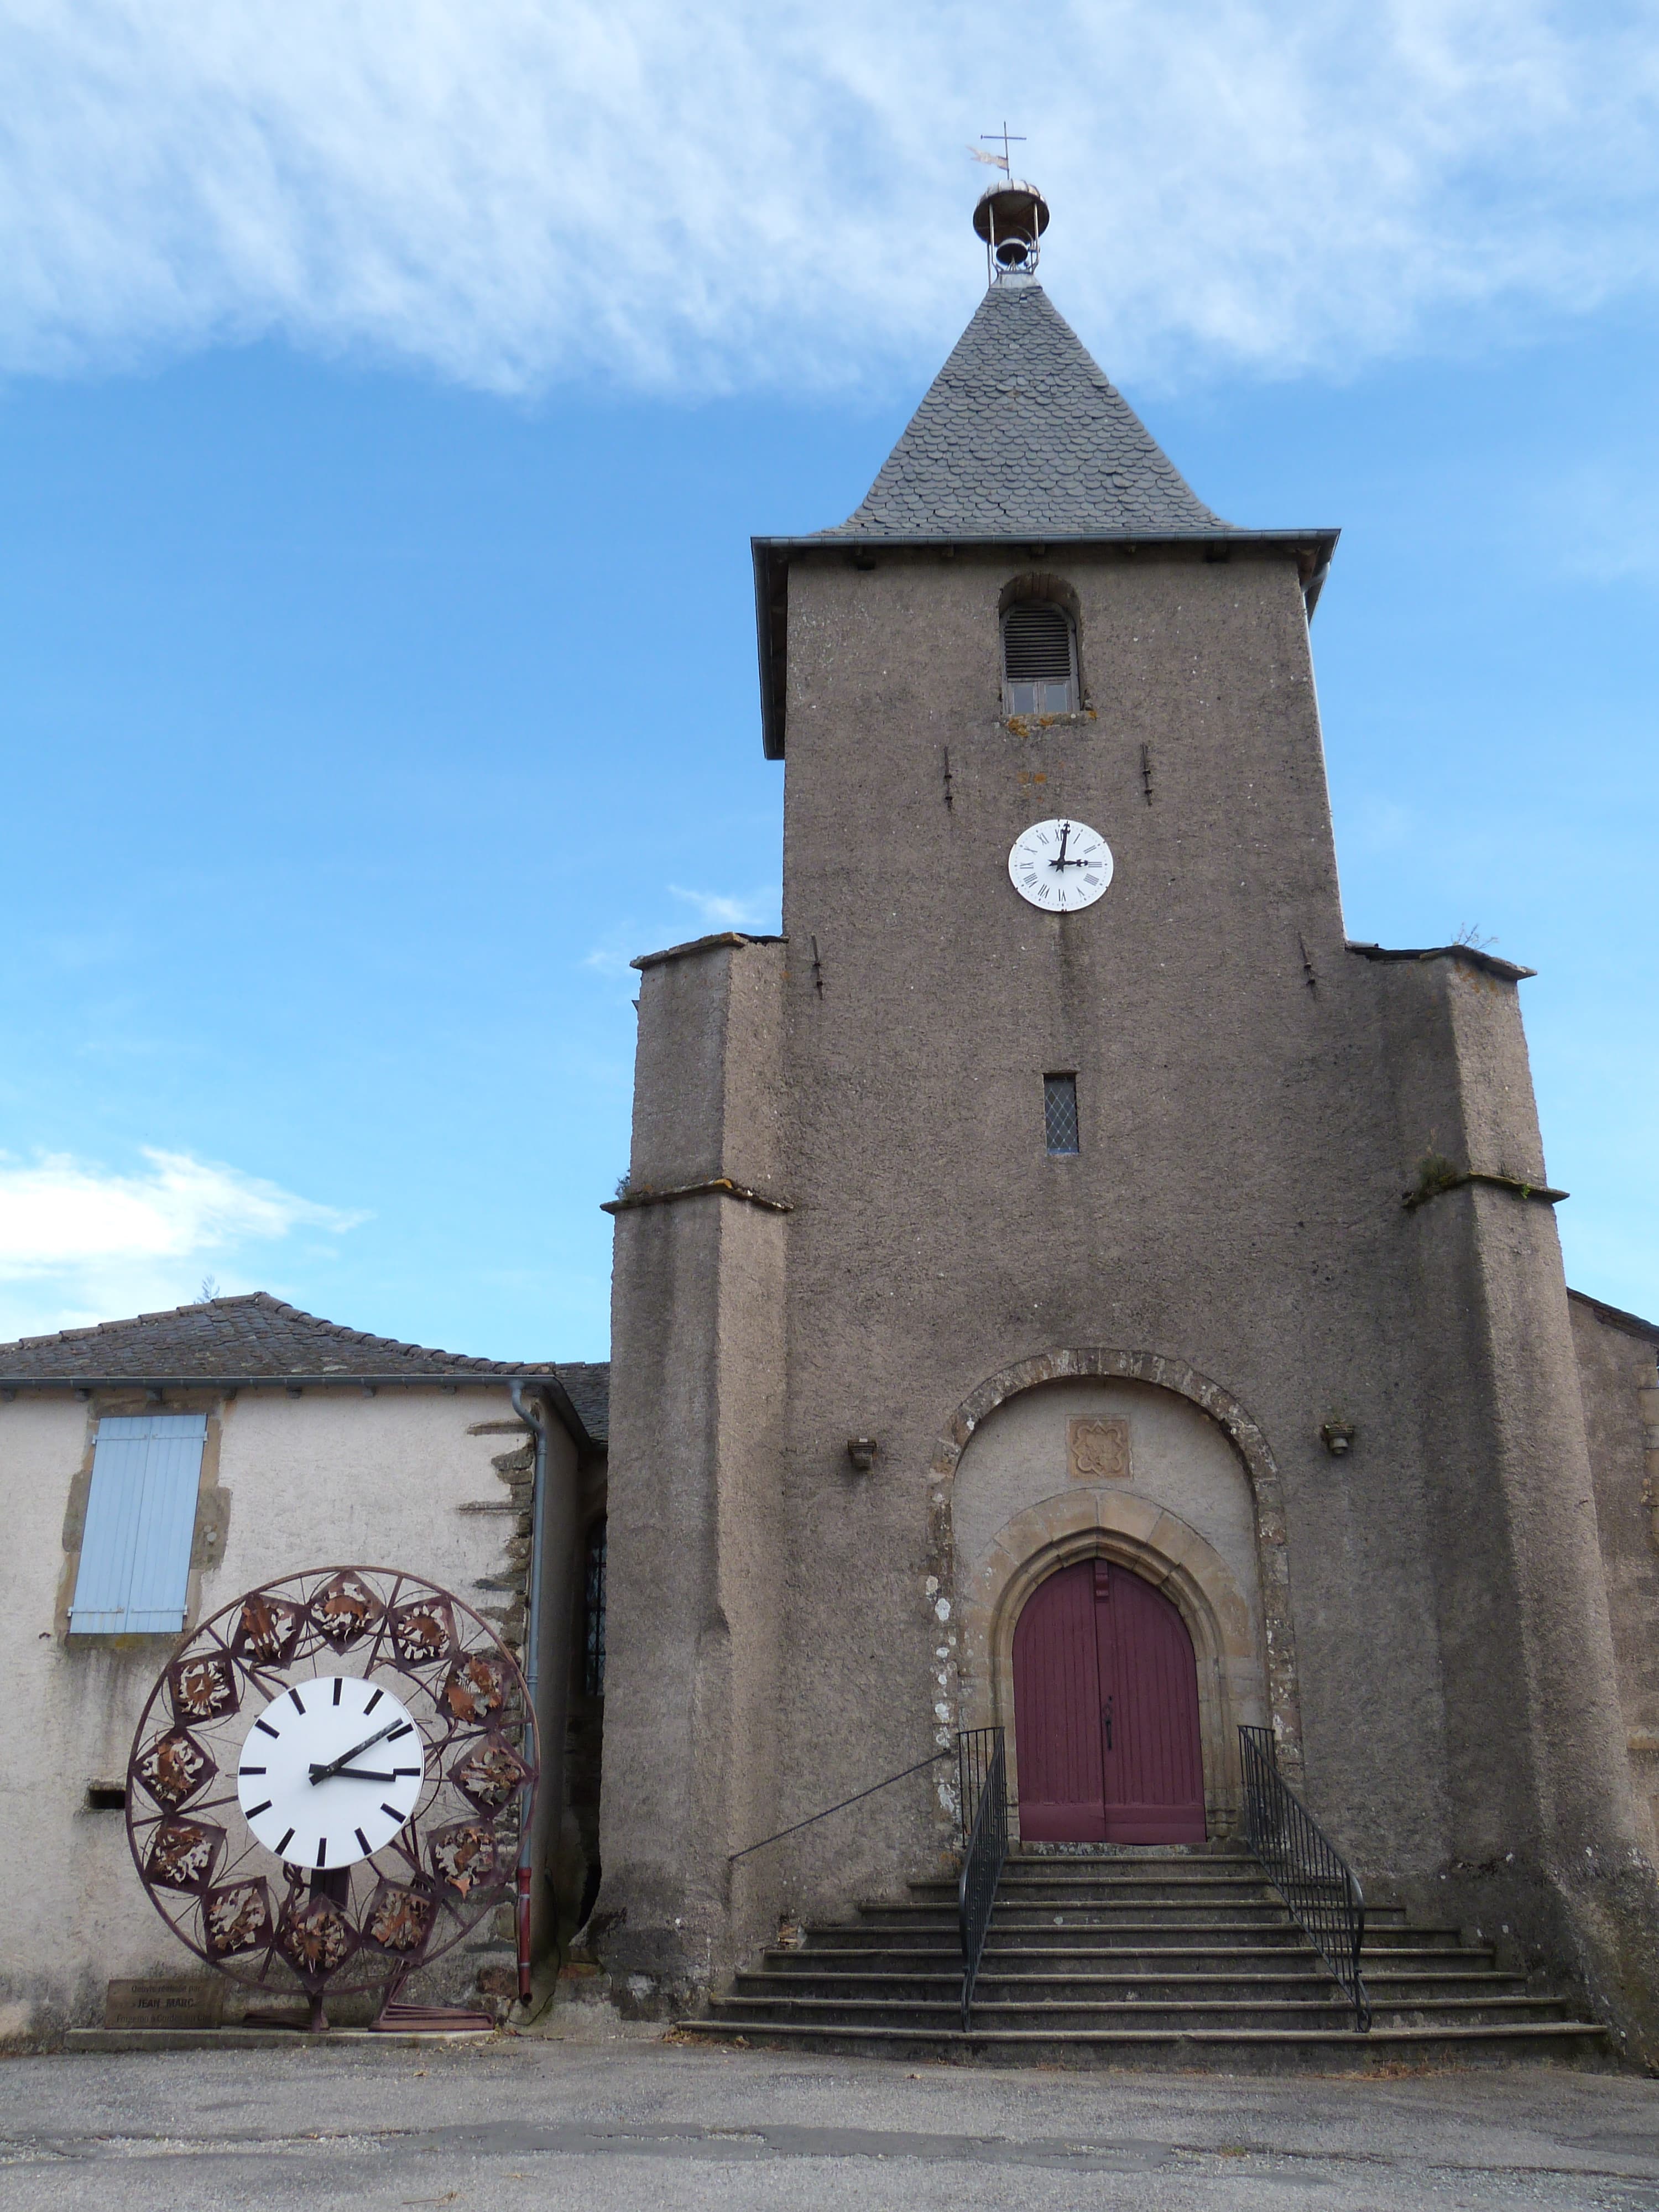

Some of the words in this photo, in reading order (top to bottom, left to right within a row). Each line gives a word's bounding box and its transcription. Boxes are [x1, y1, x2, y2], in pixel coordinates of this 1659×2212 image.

[1036, 832, 1049, 846] XI
[1073, 833, 1081, 844] I
[1024, 846, 1037, 855] X
[1083, 844, 1097, 854] II
[138, 1997, 161, 2008] JEAN
[166, 1997, 194, 2008] MARC
